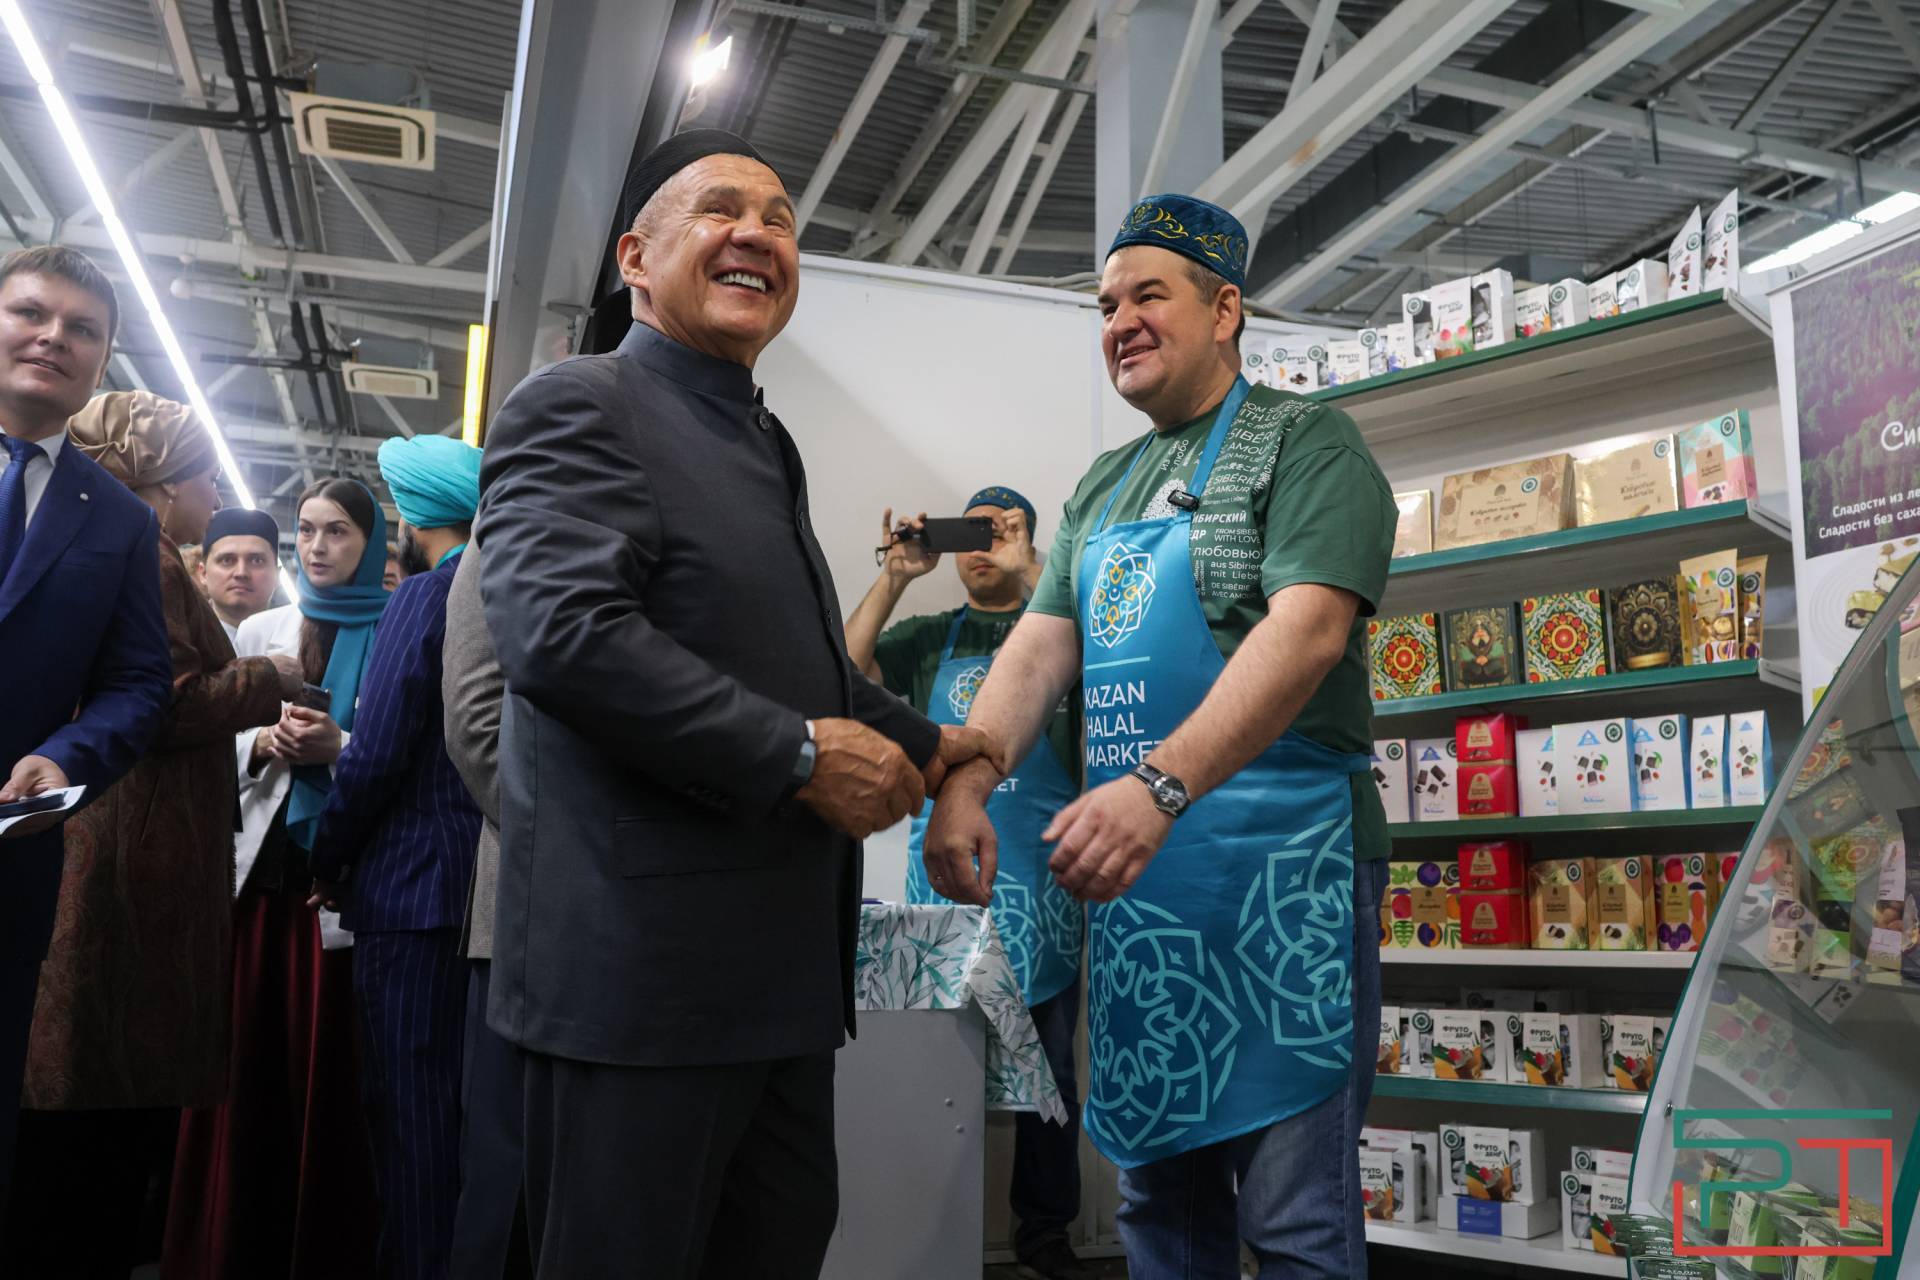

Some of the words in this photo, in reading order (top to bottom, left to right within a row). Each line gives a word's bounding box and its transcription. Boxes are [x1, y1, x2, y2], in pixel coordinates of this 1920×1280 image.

[1881, 421, 1920, 451] Си
[1833, 499, 1886, 517] Сладости
[1890, 493, 1903, 504] из
[1819, 519, 1871, 539] Сладости
[1874, 513, 1893, 525] без
[1210, 561, 1227, 569] aus
[1210, 570, 1226, 578] mit
[1084, 680, 1146, 710] KAZAN
[1086, 712, 1145, 739] HALAL
[1473, 1143, 1499, 1152] ФРУТО
